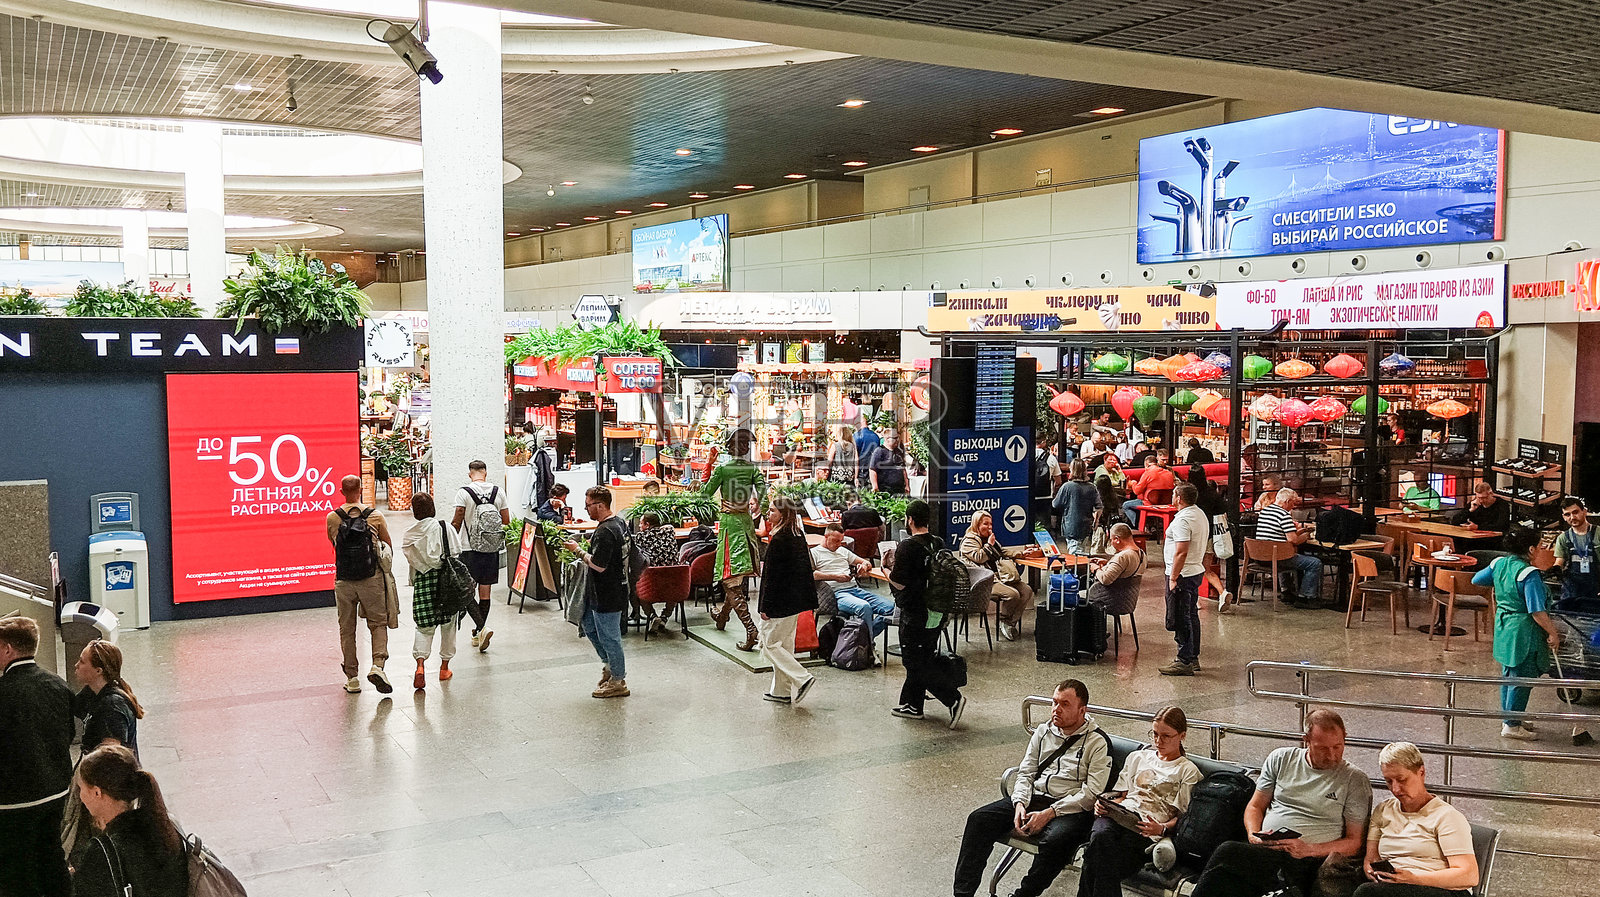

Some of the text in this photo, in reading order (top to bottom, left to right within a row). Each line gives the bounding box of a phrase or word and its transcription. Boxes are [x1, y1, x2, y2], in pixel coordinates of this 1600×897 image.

[1272, 202, 1396, 226] СМЕСИТЕЛИ ESKO
[1272, 218, 1448, 245] ВЫБИРАЙ РОССИЙСКОЕ
[691, 251, 712, 263] АРТЕКС
[1246, 289, 1276, 304] ФО-БО
[1302, 285, 1363, 303] ЛАПША И РИС
[1376, 278, 1494, 301] МАГАЗИН ТОВАРОВ ИЗ АЗИИ
[1512, 280, 1566, 299] РЕСТОРАН
[580, 304, 607, 312] ЛЕПИМ
[1330, 304, 1438, 323] ЭКЗОТИЧЕСКИЕ НАПИТКИ
[580, 315, 607, 323] ВАРИМ
[1271, 308, 1310, 325] ТОМ-ЯМ
[366, 321, 411, 347] PUTIN TEAM
[81, 332, 257, 357] TEAM
[371, 351, 409, 364] RUSSIA
[613, 363, 661, 376] COFFEE
[618, 376, 656, 389] TO GO
[197, 437, 224, 453] ДО
[954, 437, 1003, 451] ВЫХОДЫ
[953, 454, 979, 463] GATES
[953, 470, 1010, 486] 1-6, 50, 51
[231, 486, 302, 503] ЛЕТНЯЯ
[231, 500, 334, 516] РАСПРОДАЖА
[951, 498, 1001, 512] ВЫХОДЫ
[951, 515, 972, 525] GATE
